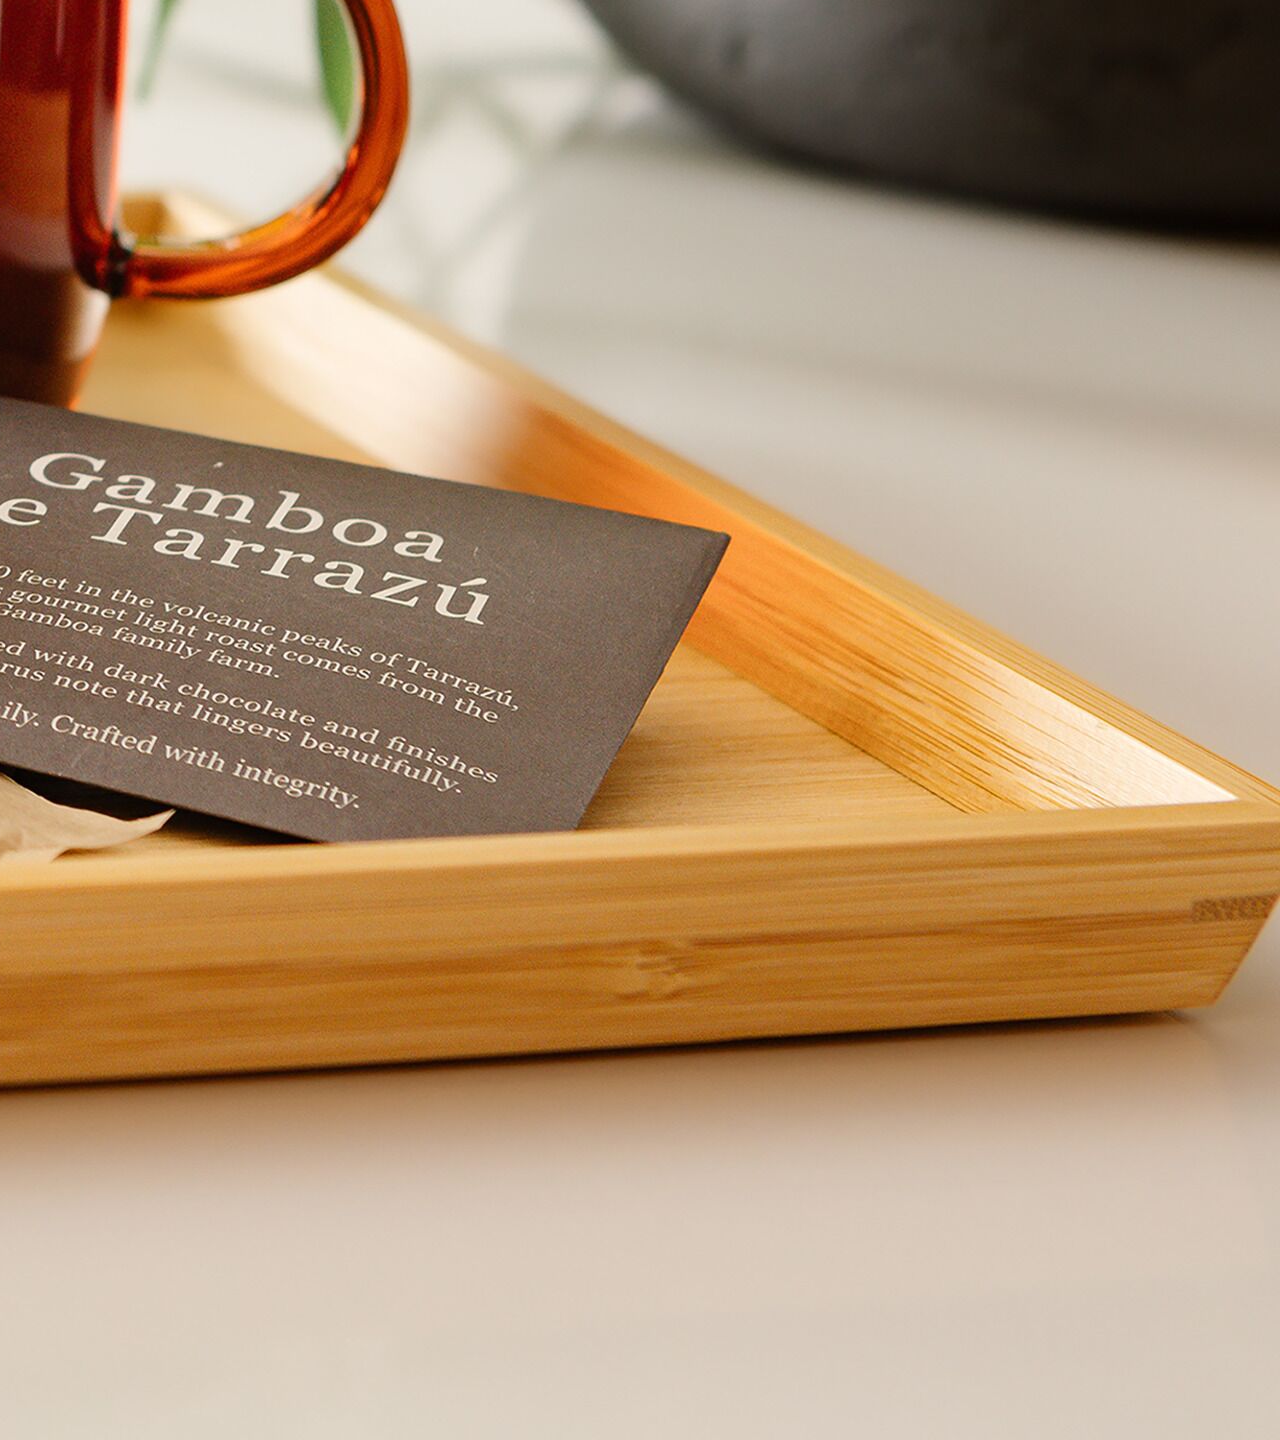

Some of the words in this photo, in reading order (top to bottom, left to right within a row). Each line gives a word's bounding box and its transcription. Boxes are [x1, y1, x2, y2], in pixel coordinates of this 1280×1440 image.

[28, 452, 445, 563] Gamboa
[90, 501, 491, 626] Tarrazú
[7, 588, 129, 624] gourmet
[132, 610, 200, 639] light
[204, 630, 278, 658] roast
[282, 648, 373, 681] comes
[378, 670, 447, 707] from
[453, 695, 501, 725] the
[17, 568, 70, 591] feet
[75, 579, 105, 599] in
[110, 588, 156, 609] the
[162, 600, 277, 637] volcanic
[280, 627, 364, 659] peaks
[369, 651, 404, 669] of
[406, 656, 521, 713] Tarrazú,
[111, 625, 203, 661] family
[206, 647, 282, 680] farm.
[32, 647, 96, 674] with
[103, 662, 173, 692] dark
[177, 681, 317, 729] chocolate
[322, 719, 381, 746] and
[385, 734, 501, 785] finishes
[49, 713, 159, 756] Crafted
[163, 744, 226, 774] with
[231, 756, 362, 811] integrity.
[52, 673, 120, 700] note
[124, 688, 187, 716] that
[190, 703, 294, 744] lingers
[299, 730, 464, 795] beautifully.
